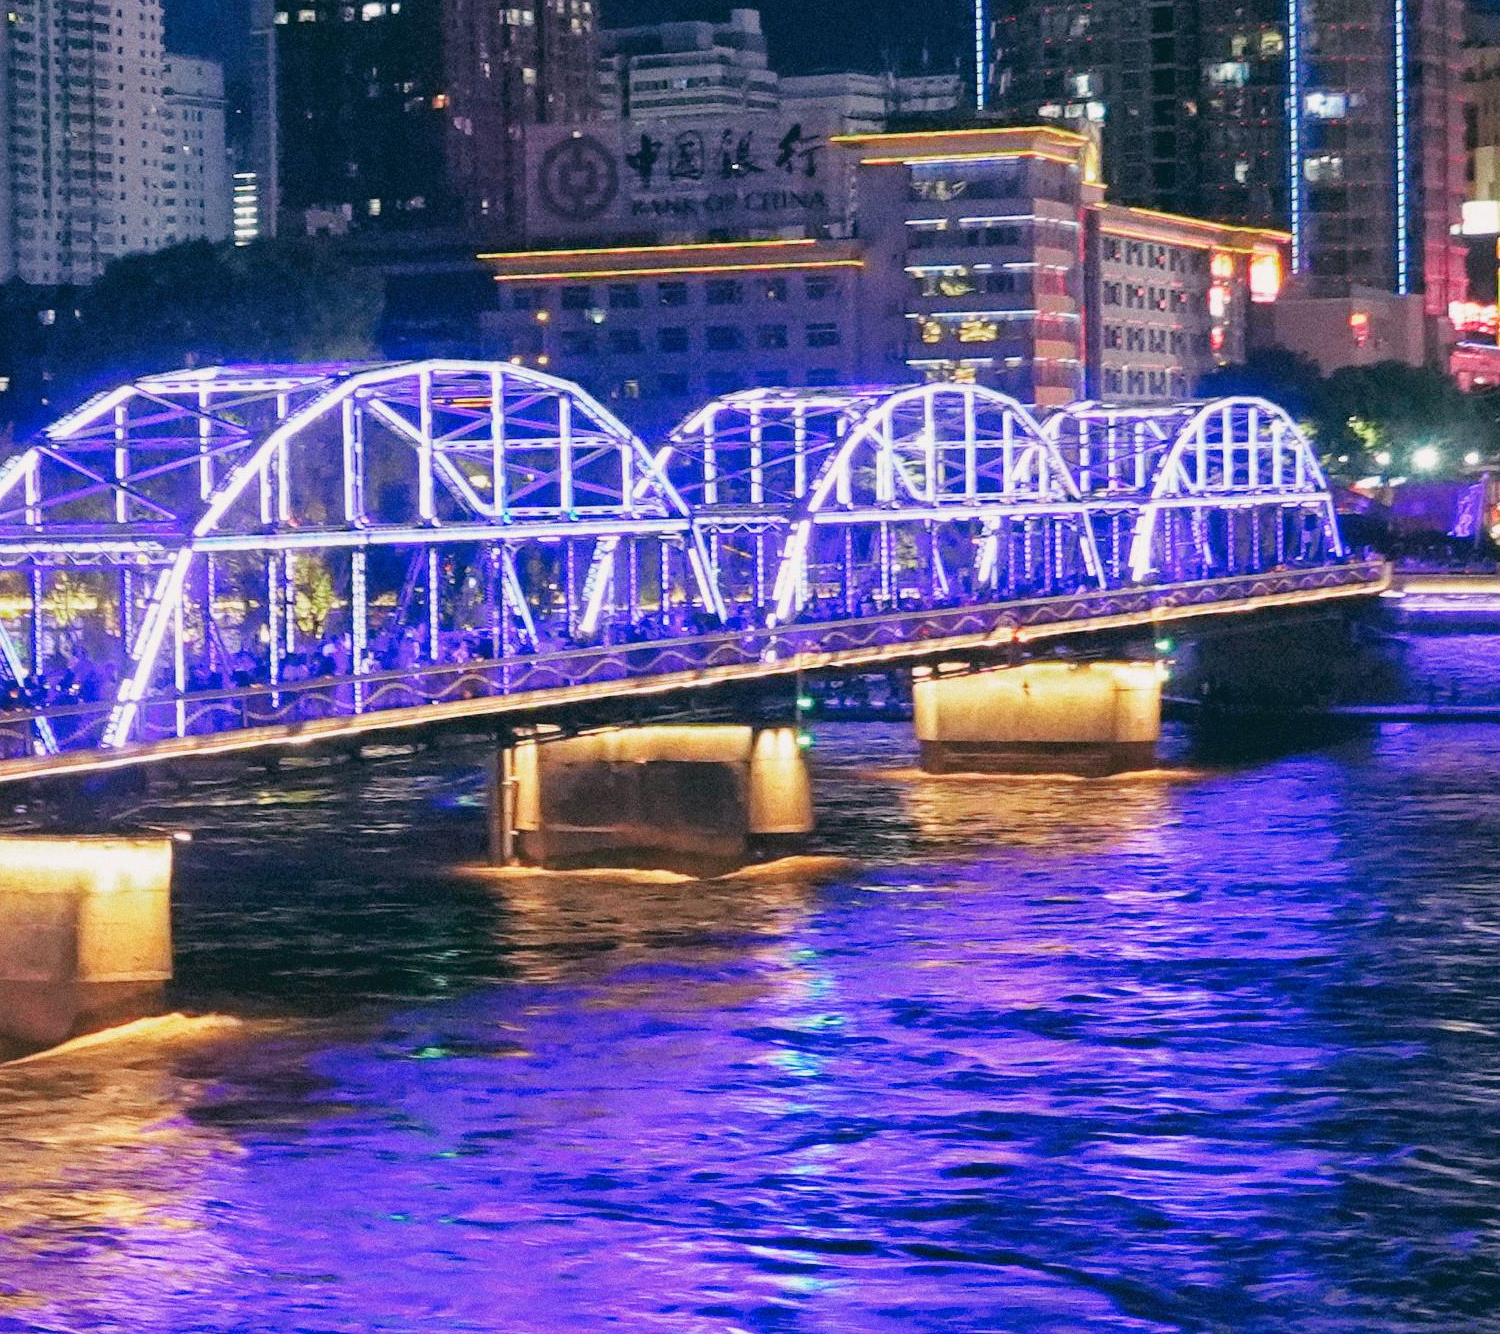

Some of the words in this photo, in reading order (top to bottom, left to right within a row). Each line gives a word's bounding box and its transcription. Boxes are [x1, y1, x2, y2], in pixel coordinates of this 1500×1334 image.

[631, 197, 698, 215] BANK
[703, 192, 738, 212] OF
[744, 189, 829, 210] CHINA
